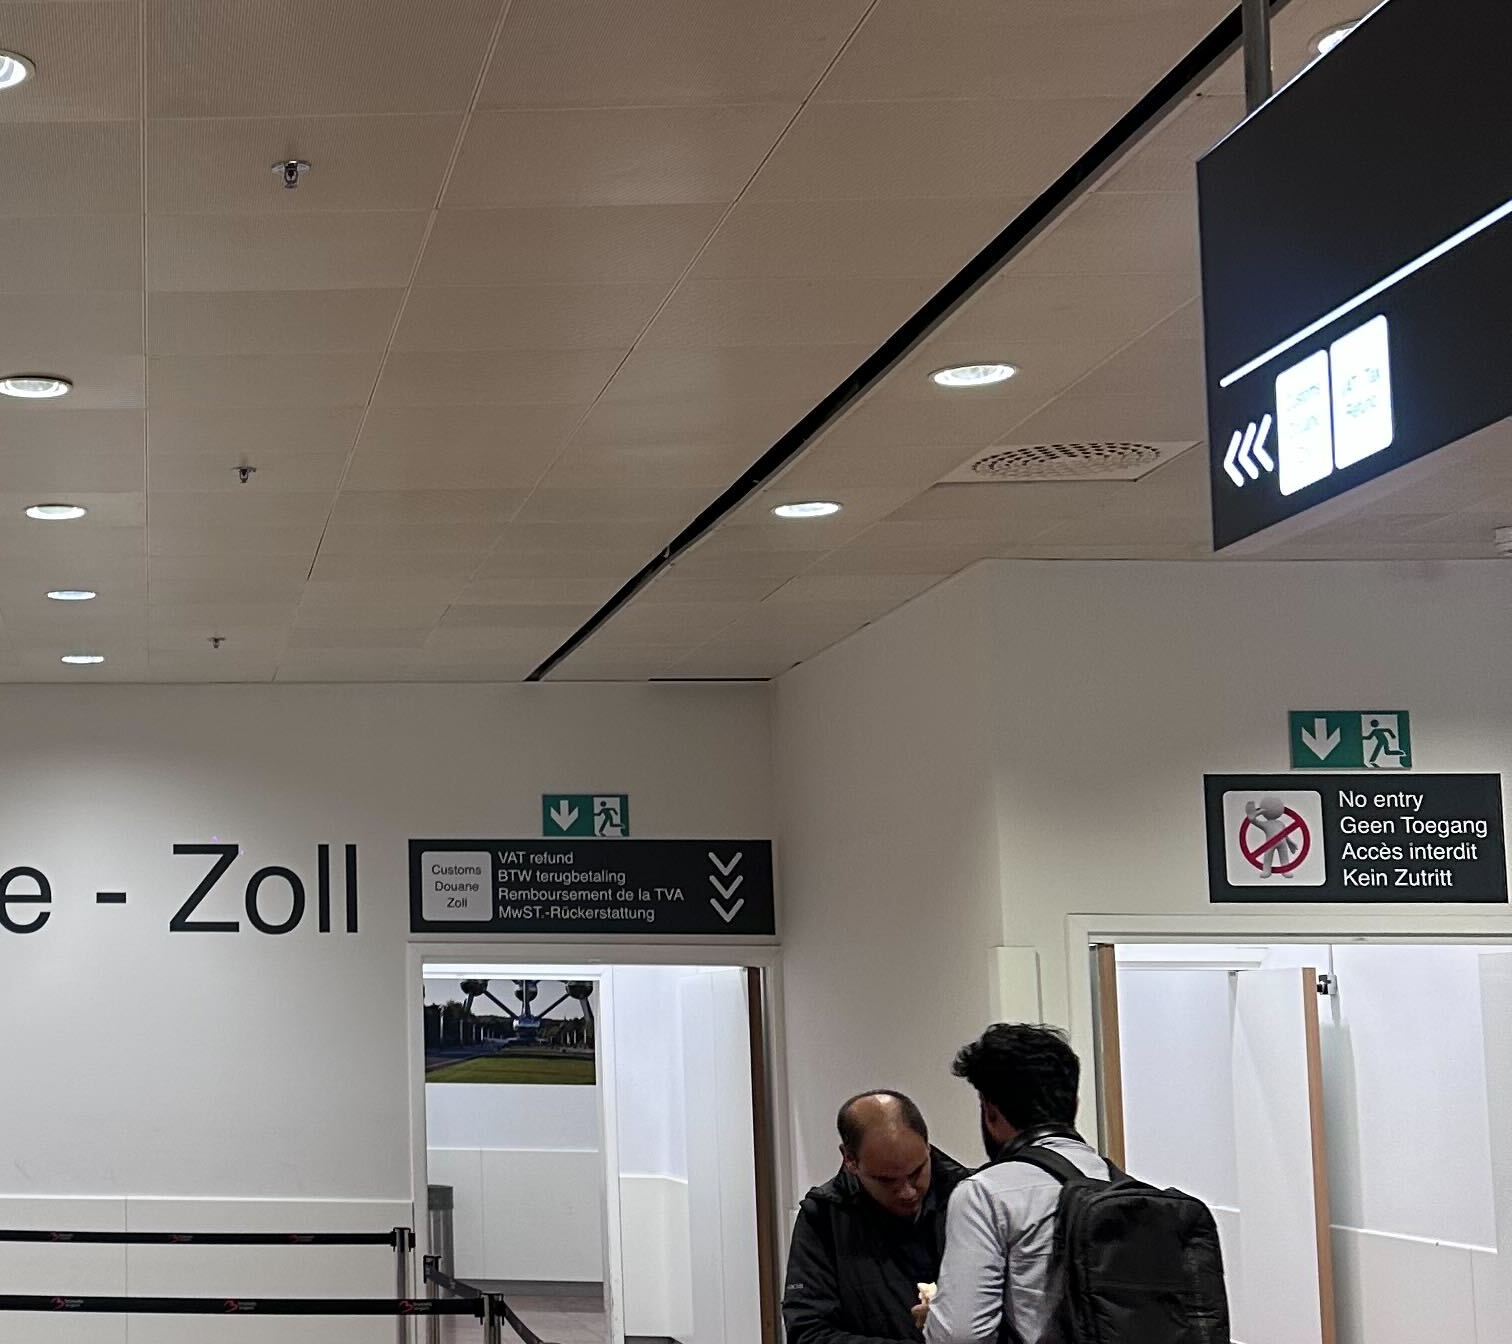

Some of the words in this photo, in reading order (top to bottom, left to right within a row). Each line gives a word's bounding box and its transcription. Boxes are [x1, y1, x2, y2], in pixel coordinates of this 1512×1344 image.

[1339, 791, 1367, 807] No
[1374, 792, 1423, 811] entry
[1341, 816, 1394, 833] Geen
[1400, 817, 1487, 838] Toegang
[498, 852, 525, 863] VAT
[530, 852, 573, 864] refund
[1342, 842, 1403, 860] Accès
[1410, 843, 1477, 860] interdit
[432, 864, 481, 875] Customs
[499, 870, 532, 881] BTW
[536, 870, 625, 885] terugbetaling
[1344, 869, 1387, 886] Kein
[1395, 869, 1452, 886] Zutritt
[96, 890, 127, 904] -
[169, 843, 358, 934] Zoll
[434, 881, 479, 891] Douane
[499, 888, 612, 900] Remboursement
[617, 888, 633, 901] de
[639, 888, 650, 901] la
[654, 888, 684, 900] TVA
[447, 897, 467, 908] Zoll
[499, 906, 654, 922] MwST.-Rückerstattung
